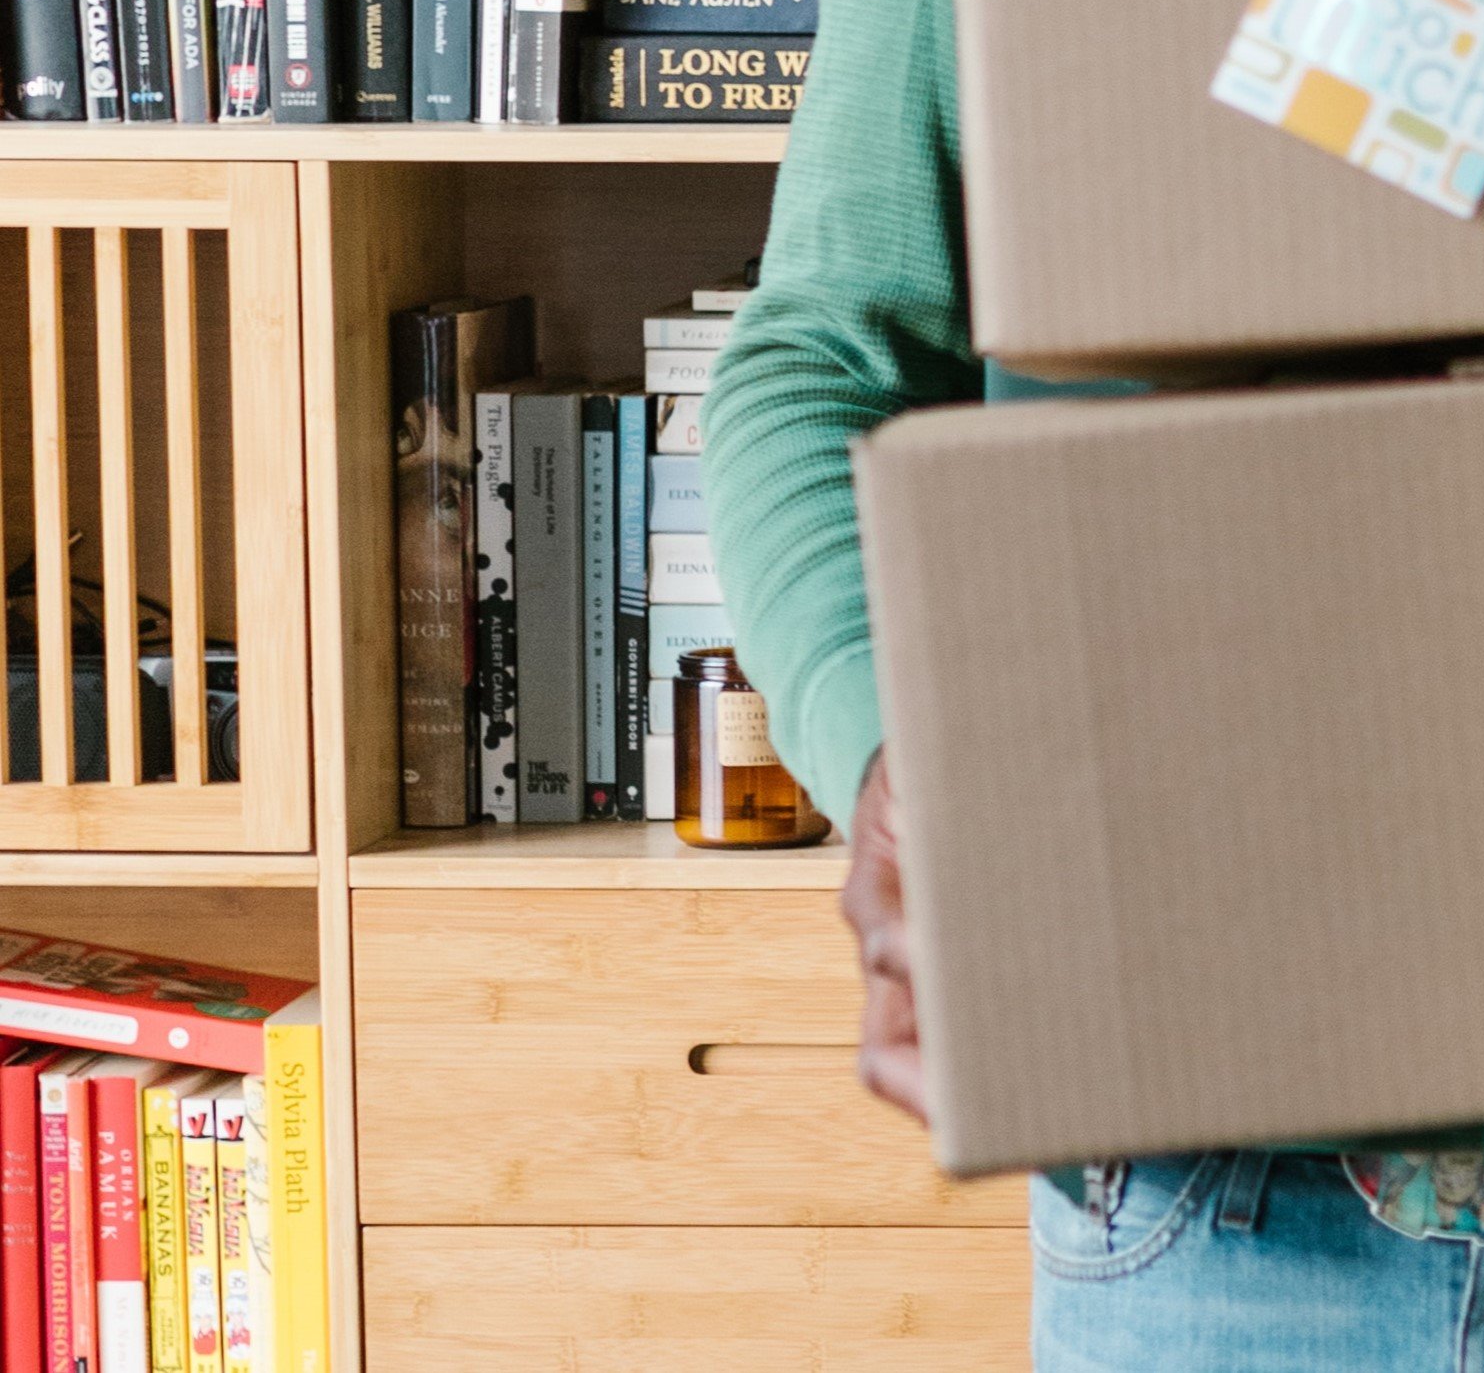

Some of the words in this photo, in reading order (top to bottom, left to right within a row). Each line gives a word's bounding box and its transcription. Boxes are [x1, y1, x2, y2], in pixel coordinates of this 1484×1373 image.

[88, 6, 111, 64] CLASS
[183, 32, 200, 70] ADA
[366, 5, 384, 70] WILLIAMS
[658, 48, 766, 77] LONG
[775, 50, 811, 77] W
[17, 75, 66, 100] polity
[609, 46, 626, 110] Mandela
[659, 82, 713, 109] TO
[668, 366, 706, 379] FOO
[487, 405, 503, 437] The
[624, 408, 642, 475] JAMES
[486, 444, 503, 503] Plague
[546, 447, 556, 465] The
[546, 467, 556, 502] School
[592, 434, 604, 542] TALKING
[546, 516, 556, 536] Life
[625, 482, 642, 574] BALDWIN
[593, 557, 603, 580] IT
[667, 563, 708, 574] ELENA
[490, 616, 503, 668] ALBERT
[593, 596, 603, 657] OVER
[666, 636, 707, 647] ELENA
[710, 636, 736, 647] FER
[492, 672, 504, 723] CAMUS
[627, 637, 638, 711] GIOVANNI'S
[628, 714, 639, 751] ROOM
[274, 1062, 307, 1141] Sylvia
[49, 1171, 66, 1232] TONI
[98, 1130, 118, 1240] PAMUK
[120, 1148, 135, 1222] ORHAN
[284, 1148, 310, 1214] Plath
[154, 1160, 174, 1277] BANANAS
[50, 1242, 69, 1373] MORRISON
